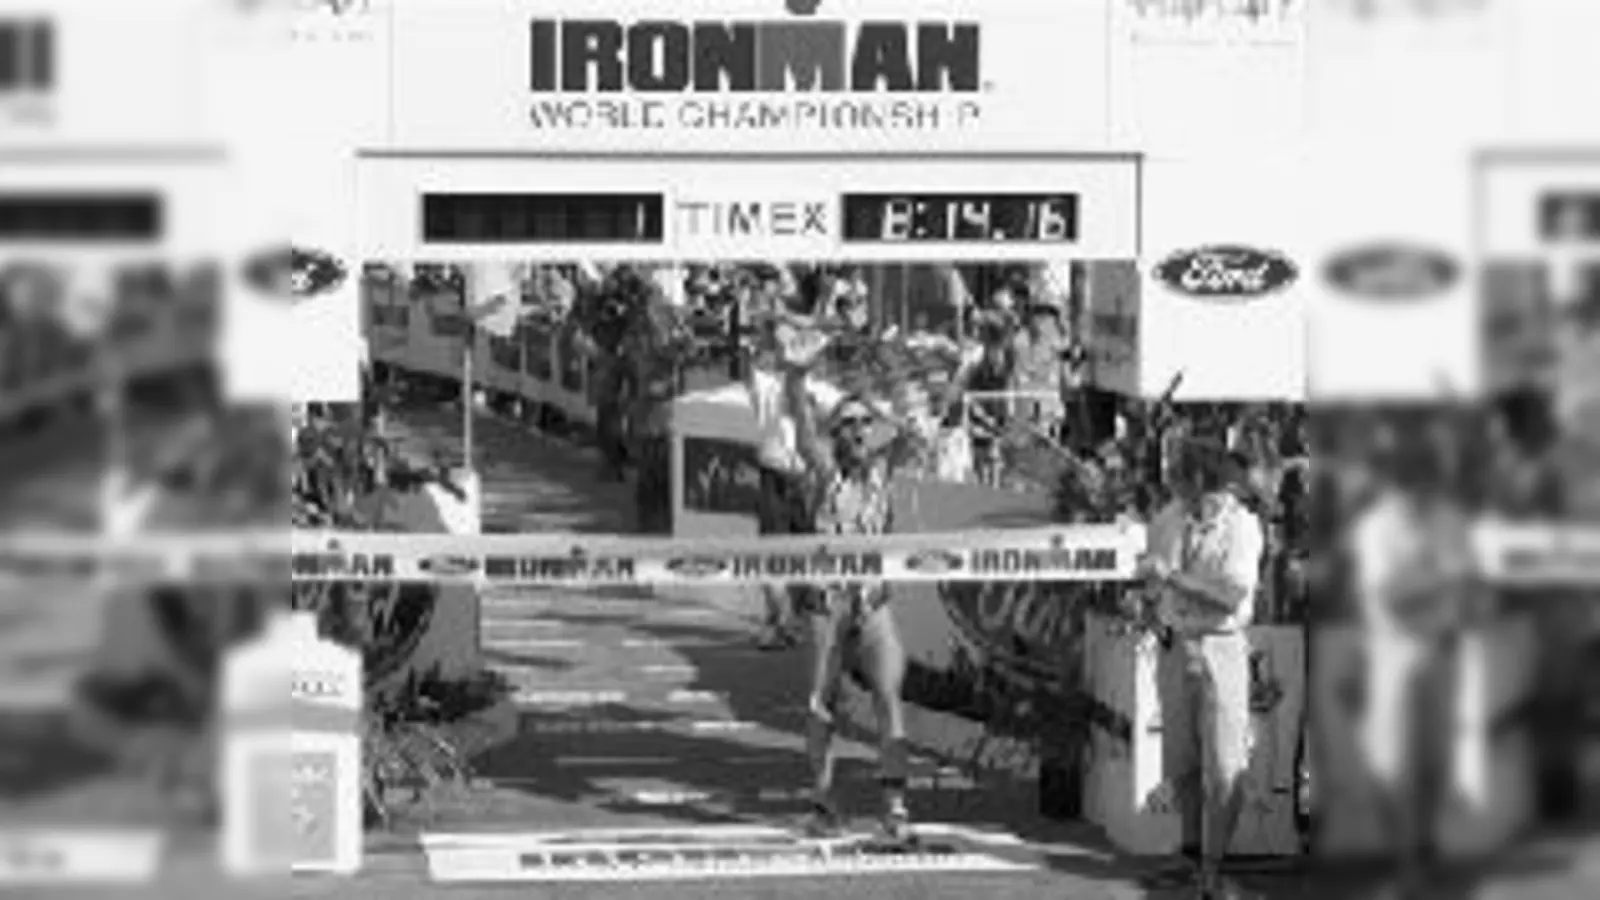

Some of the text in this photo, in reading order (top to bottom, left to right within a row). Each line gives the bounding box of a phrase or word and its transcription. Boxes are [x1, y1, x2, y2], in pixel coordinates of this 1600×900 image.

[530, 20, 980, 92] IRONMAN
[529, 101, 980, 129] WORLD CHAMPIONSHP
[676, 202, 828, 236] TIMEX
